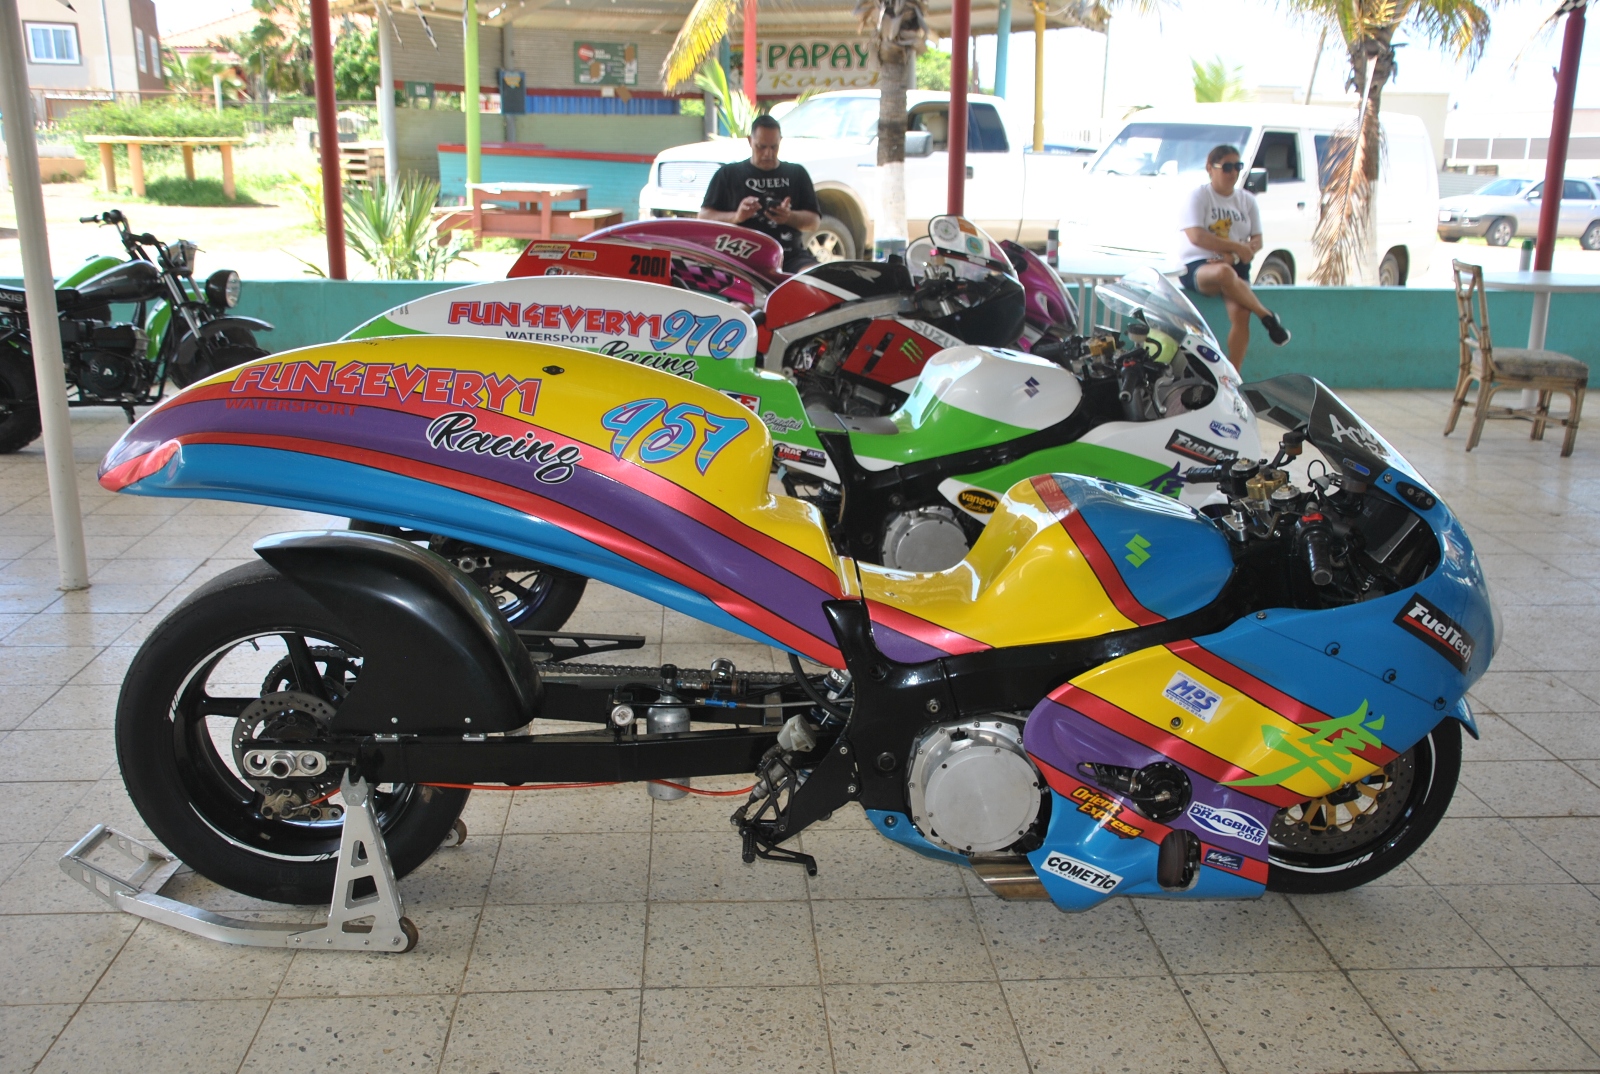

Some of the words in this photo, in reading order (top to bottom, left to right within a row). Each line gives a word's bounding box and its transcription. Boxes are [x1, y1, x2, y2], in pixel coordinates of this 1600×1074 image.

[745, 178, 790, 193] QUEEN
[1211, 207, 1247, 224] SIMBA
[715, 234, 762, 259] 147
[629, 254, 667, 277] 2001
[505, 331, 598, 345] WATERSPORT
[911, 319, 960, 349] SUZU
[229, 360, 542, 416] FUN4EVERY1
[225, 398, 361, 417] WATERSPORT
[425, 411, 583, 485] Racing
[601, 398, 749, 476] 457
[779, 446, 802, 457] TRAC
[961, 492, 999, 509] vanson
[1407, 601, 1472, 663] FuelTech
[1169, 679, 1218, 710] MPS
[1071, 787, 1123, 814] Orient
[1078, 801, 1143, 837] Express
[1190, 806, 1265, 837] DRAGBIKE
[1047, 856, 1117, 890] COMETIC
